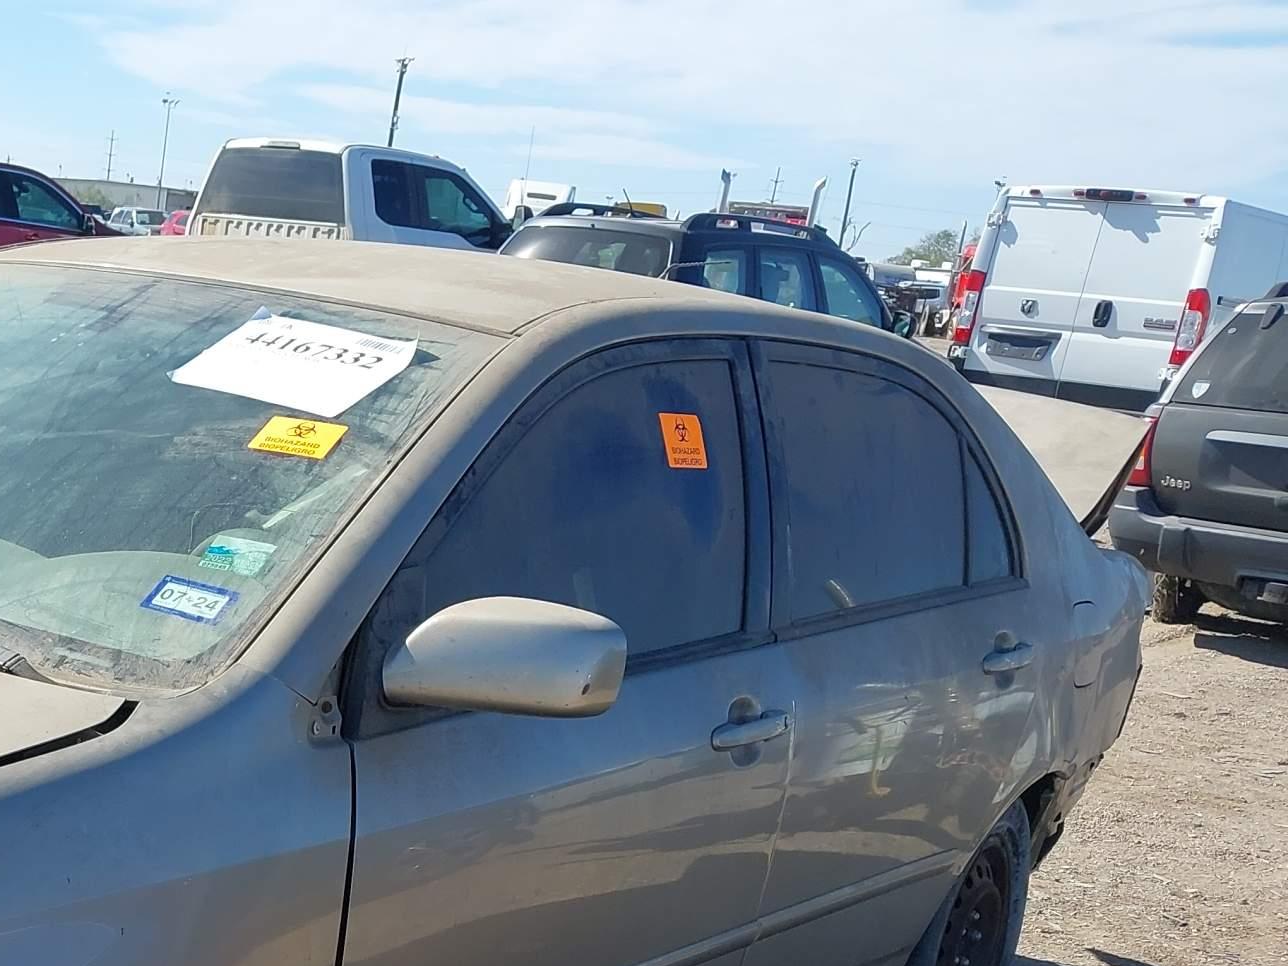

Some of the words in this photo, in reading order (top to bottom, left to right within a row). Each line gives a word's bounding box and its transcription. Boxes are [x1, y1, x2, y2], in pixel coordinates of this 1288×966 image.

[245, 332, 383, 369] 44167332
[258, 442, 316, 455] BIOPELIGRO
[265, 436, 321, 449] BIOHAZARD
[1161, 475, 1191, 491] Jeep
